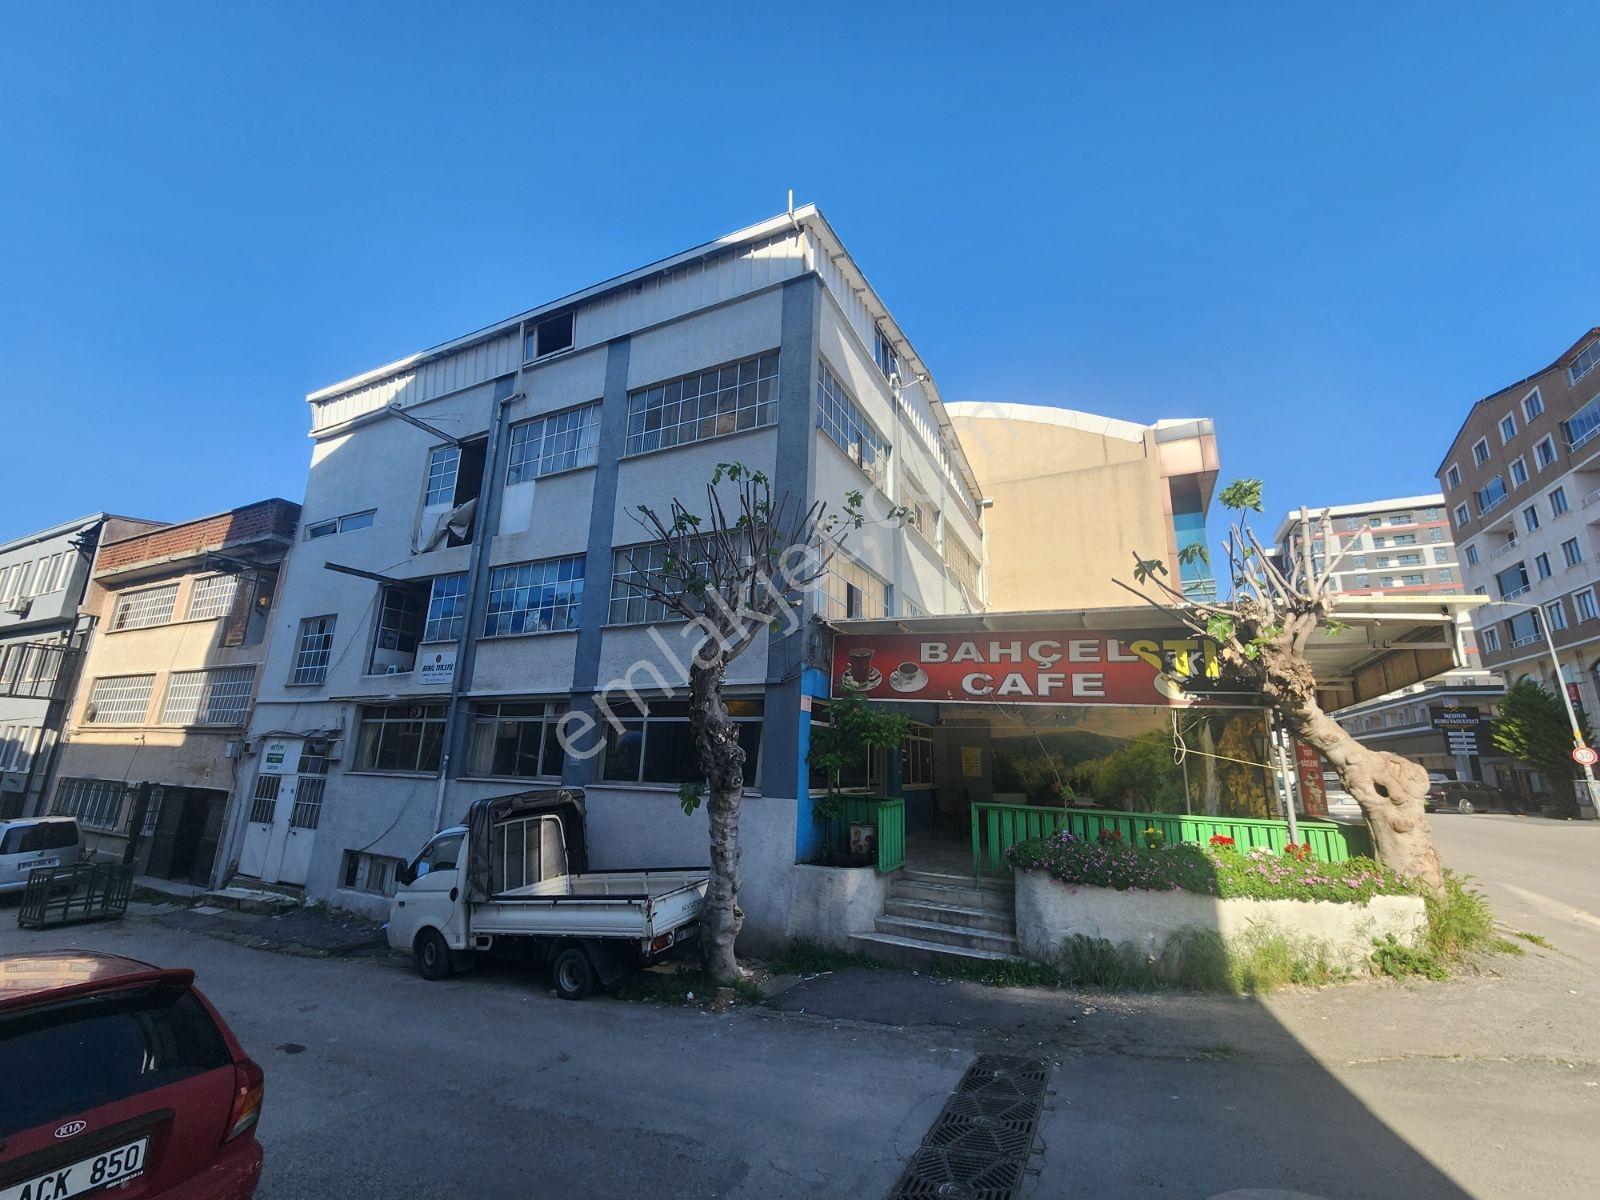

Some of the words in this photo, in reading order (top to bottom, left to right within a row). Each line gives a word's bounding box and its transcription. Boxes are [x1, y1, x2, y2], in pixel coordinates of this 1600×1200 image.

[961, 672, 1106, 697] CAFE
[1578, 751, 1591, 761] 30
[59, 1122, 82, 1136] KIA
[19, 1168, 72, 1200] ACK
[90, 1144, 140, 1185] 850
